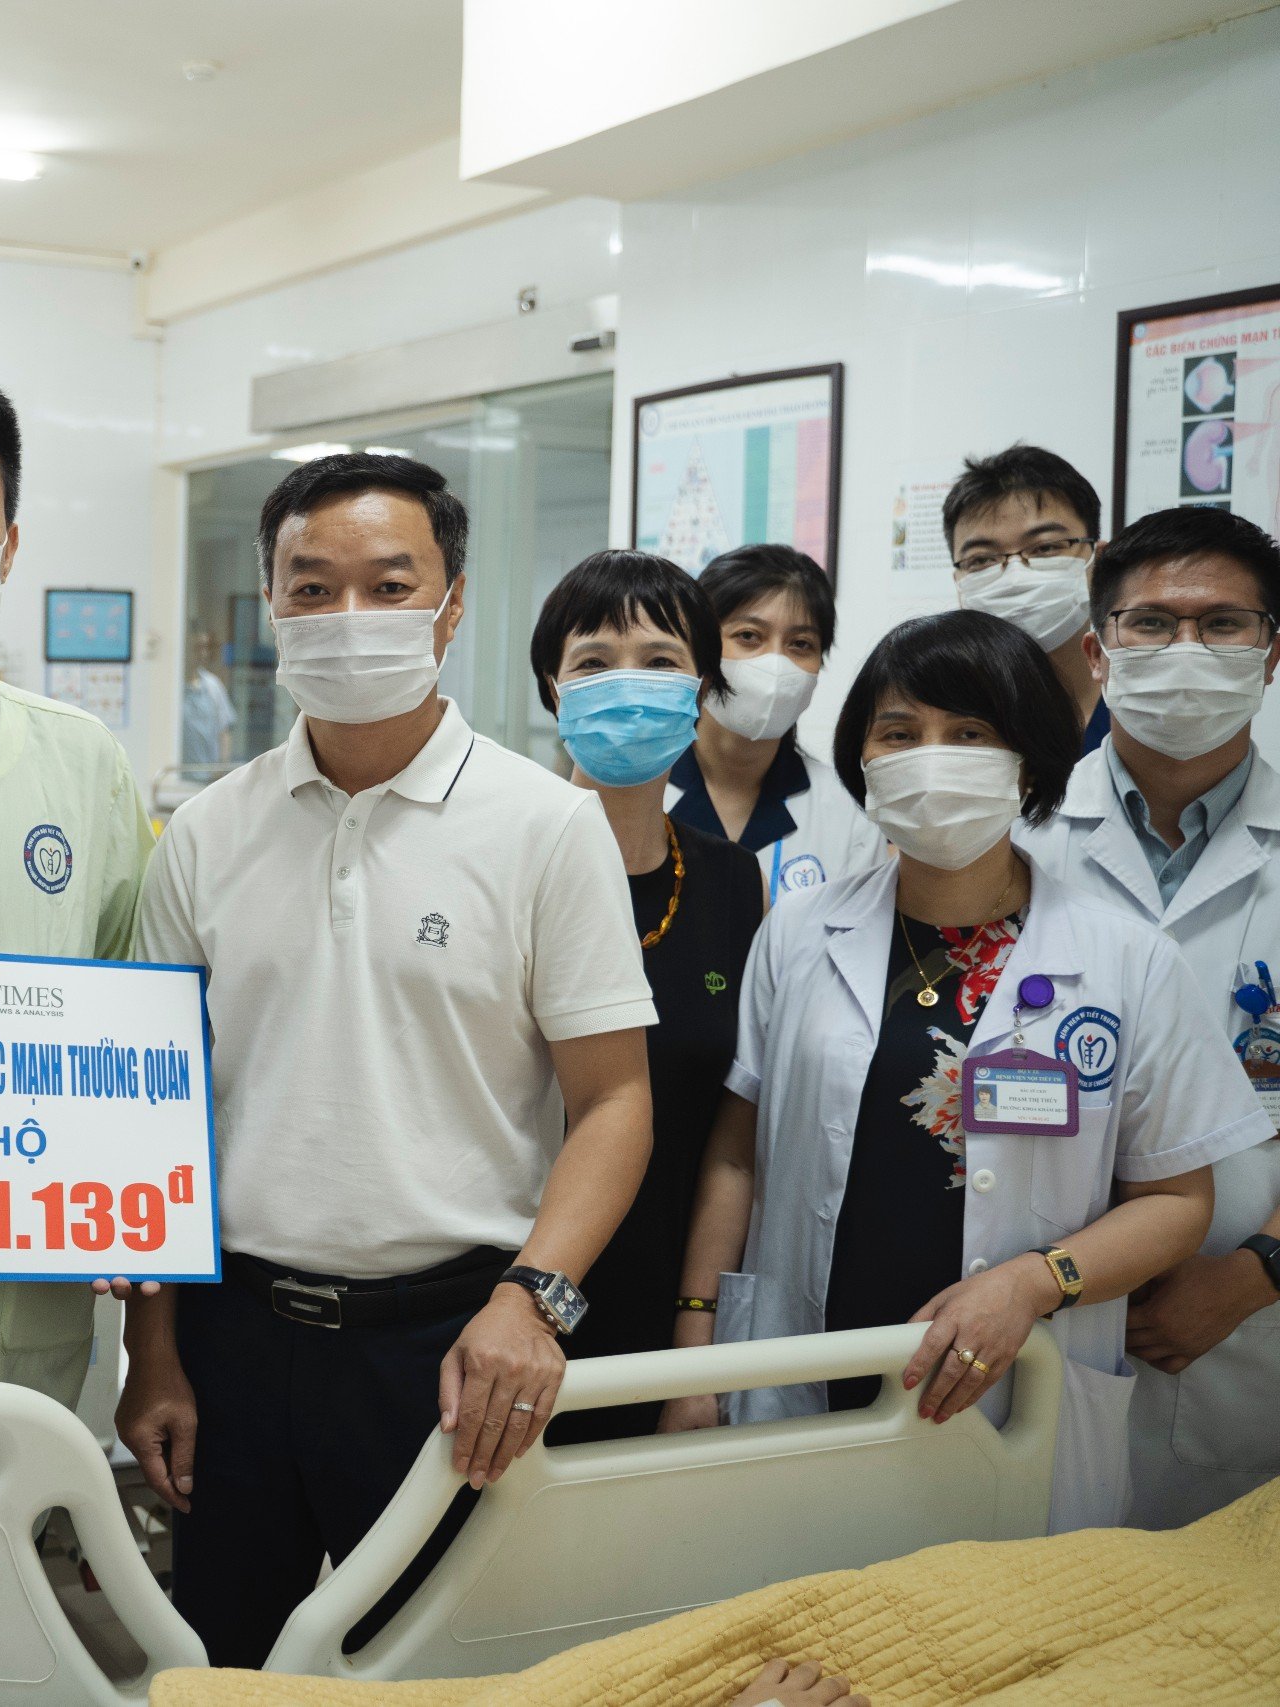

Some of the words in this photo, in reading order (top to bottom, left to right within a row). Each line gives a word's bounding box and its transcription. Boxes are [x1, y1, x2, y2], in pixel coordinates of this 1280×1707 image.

[23, 1010, 64, 1018] ANALYSIS
[11, 1043, 63, 1106] MẠNH
[67, 1032, 139, 1099] THƯỜNG
[144, 1040, 190, 1105] QUÂN
